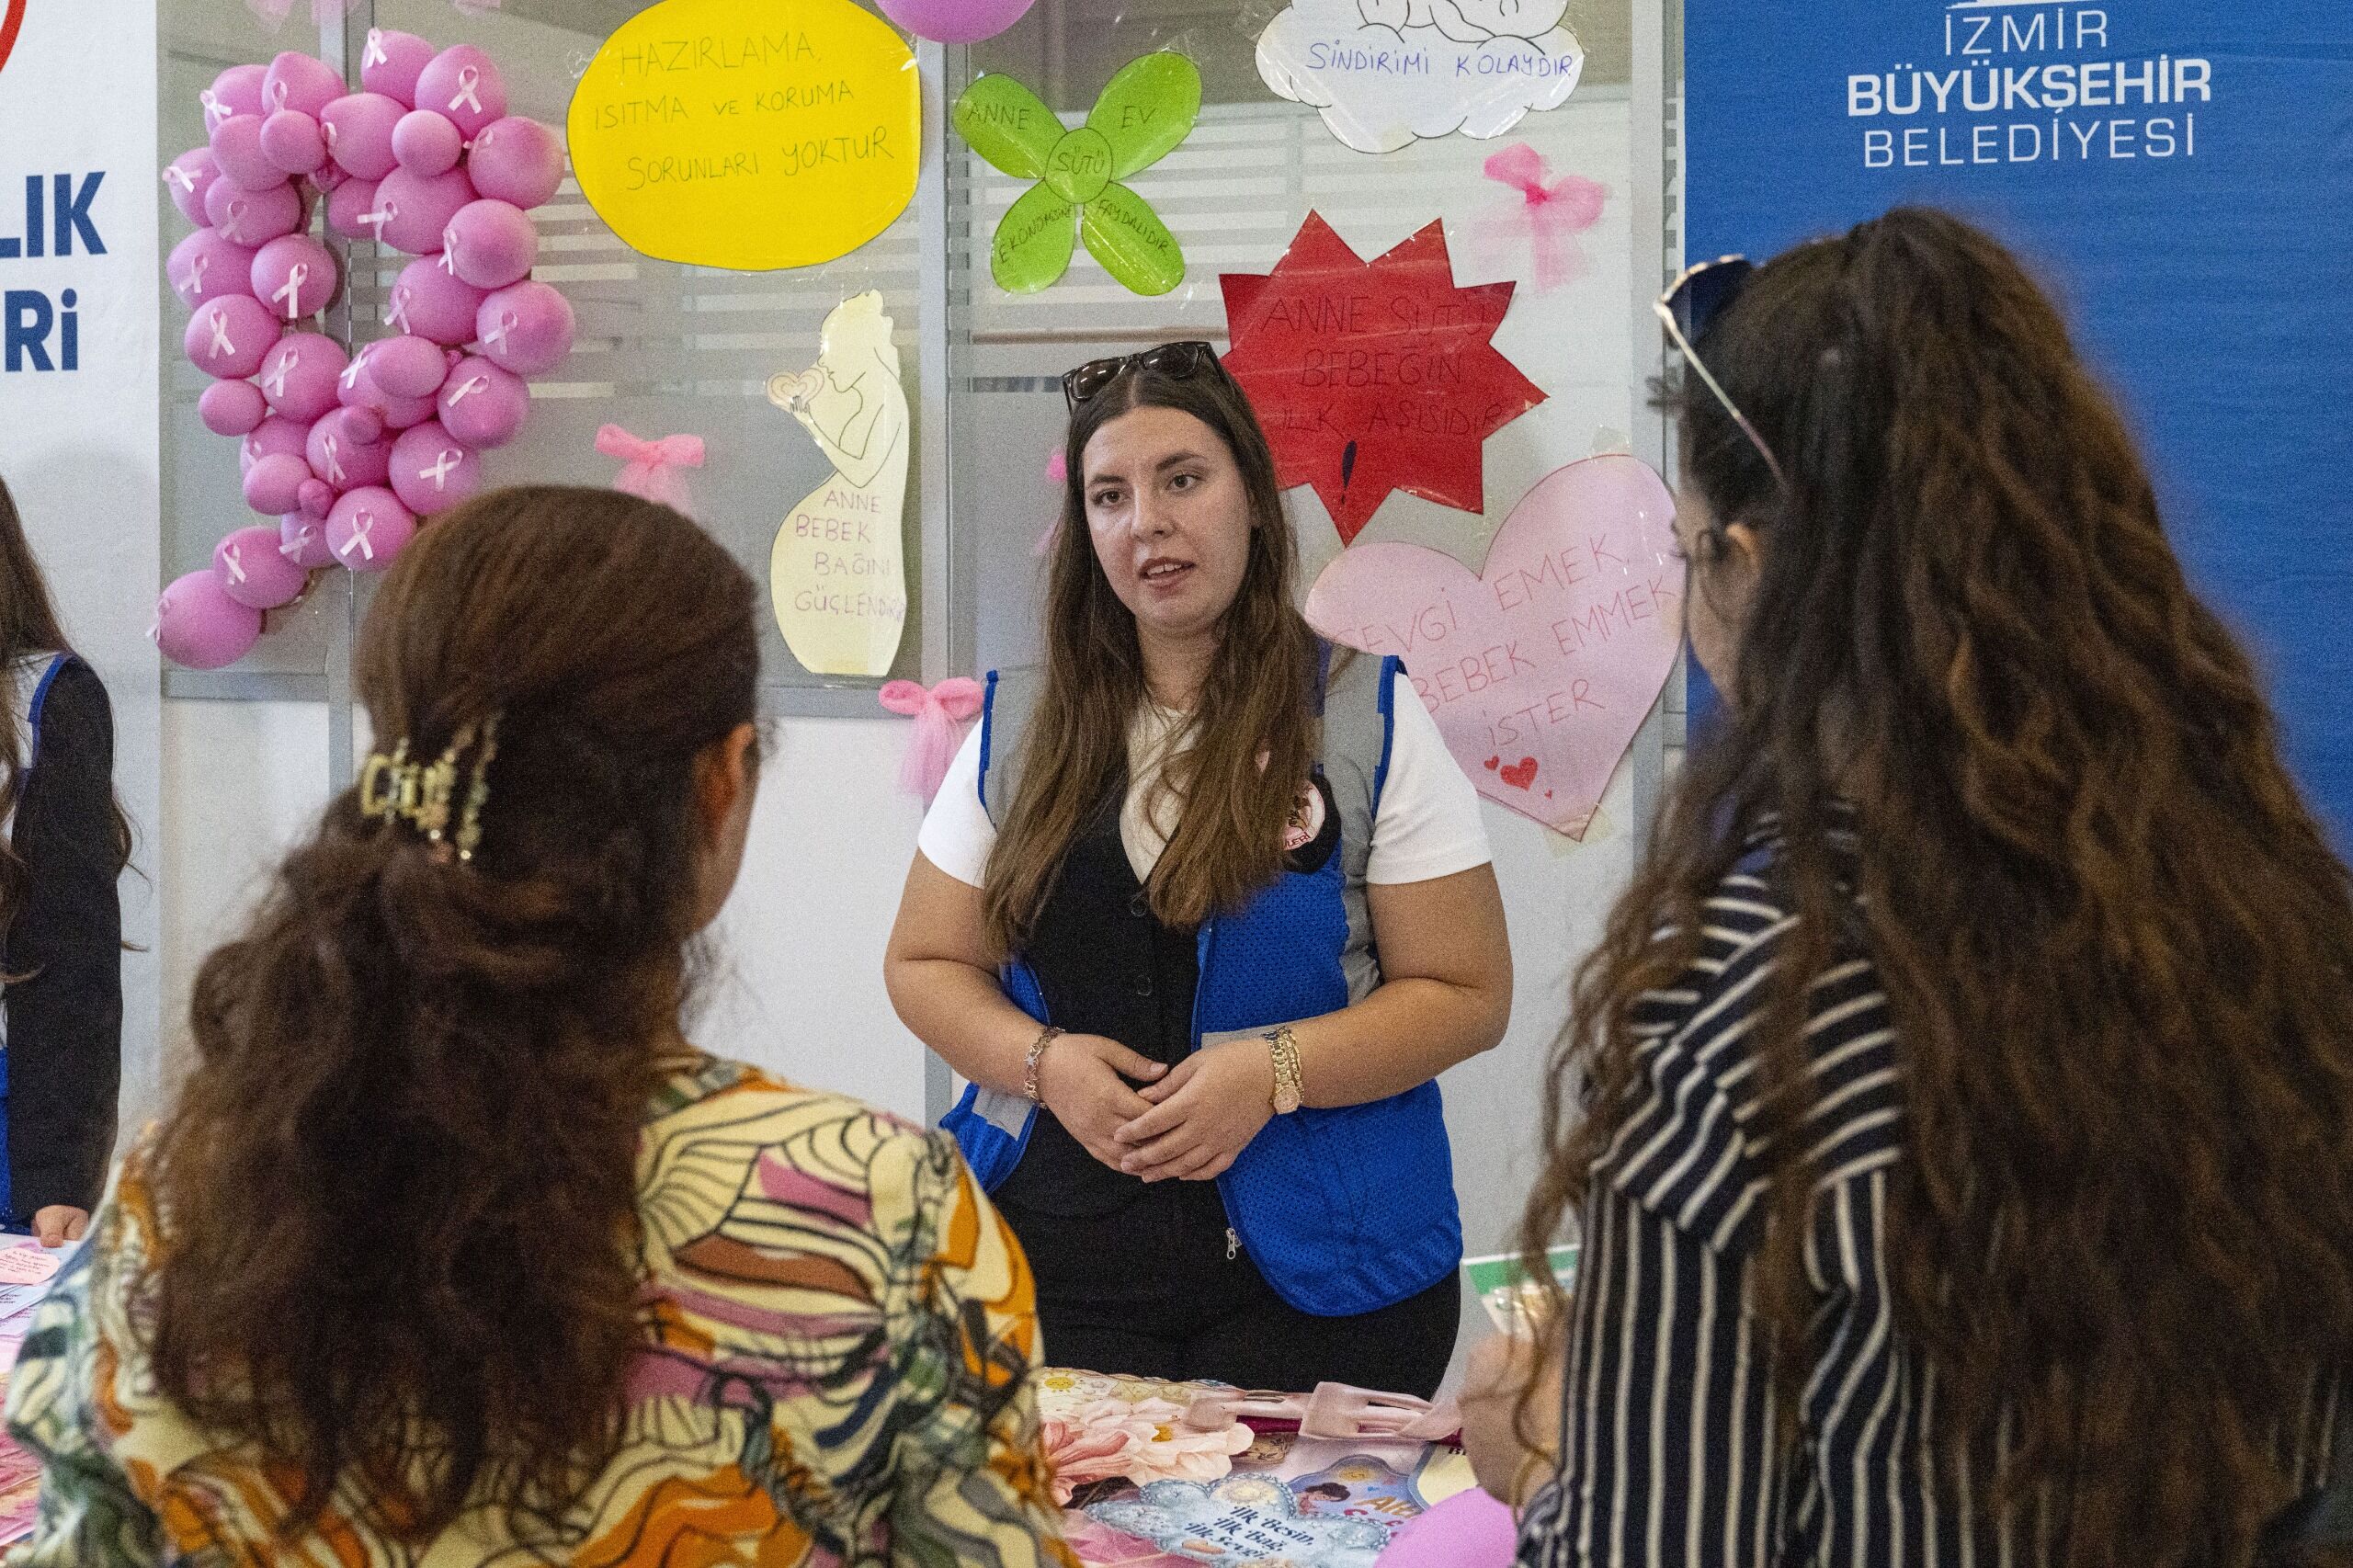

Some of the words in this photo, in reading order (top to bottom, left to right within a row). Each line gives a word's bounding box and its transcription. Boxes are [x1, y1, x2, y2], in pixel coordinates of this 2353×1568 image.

[1944, 7, 2109, 56] İZMİR
[1305, 39, 1429, 74] SİNDİRİMİ
[596, 95, 689, 130] ISITMA
[756, 80, 854, 112] KORUMA
[1847, 53, 2211, 115] BÜYÜKŞEHİR
[966, 103, 1029, 130] ANNE
[1121, 106, 1156, 129] EV
[1864, 112, 2195, 168] BELEDİYESİ
[626, 152, 759, 191] SORUNLARI
[782, 125, 894, 176] YOKTUR
[1056, 145, 1105, 175] SÜTÜ
[1260, 296, 1370, 334] ANNE
[1386, 289, 1485, 337] SÜTÜ
[824, 490, 881, 513] ANNE
[796, 514, 871, 543] BEBEK
[814, 551, 890, 576] BAĞINI
[1412, 640, 1537, 713] BEBEK
[1552, 574, 1677, 656] EMMEK
[1483, 678, 1605, 747] İSTER
